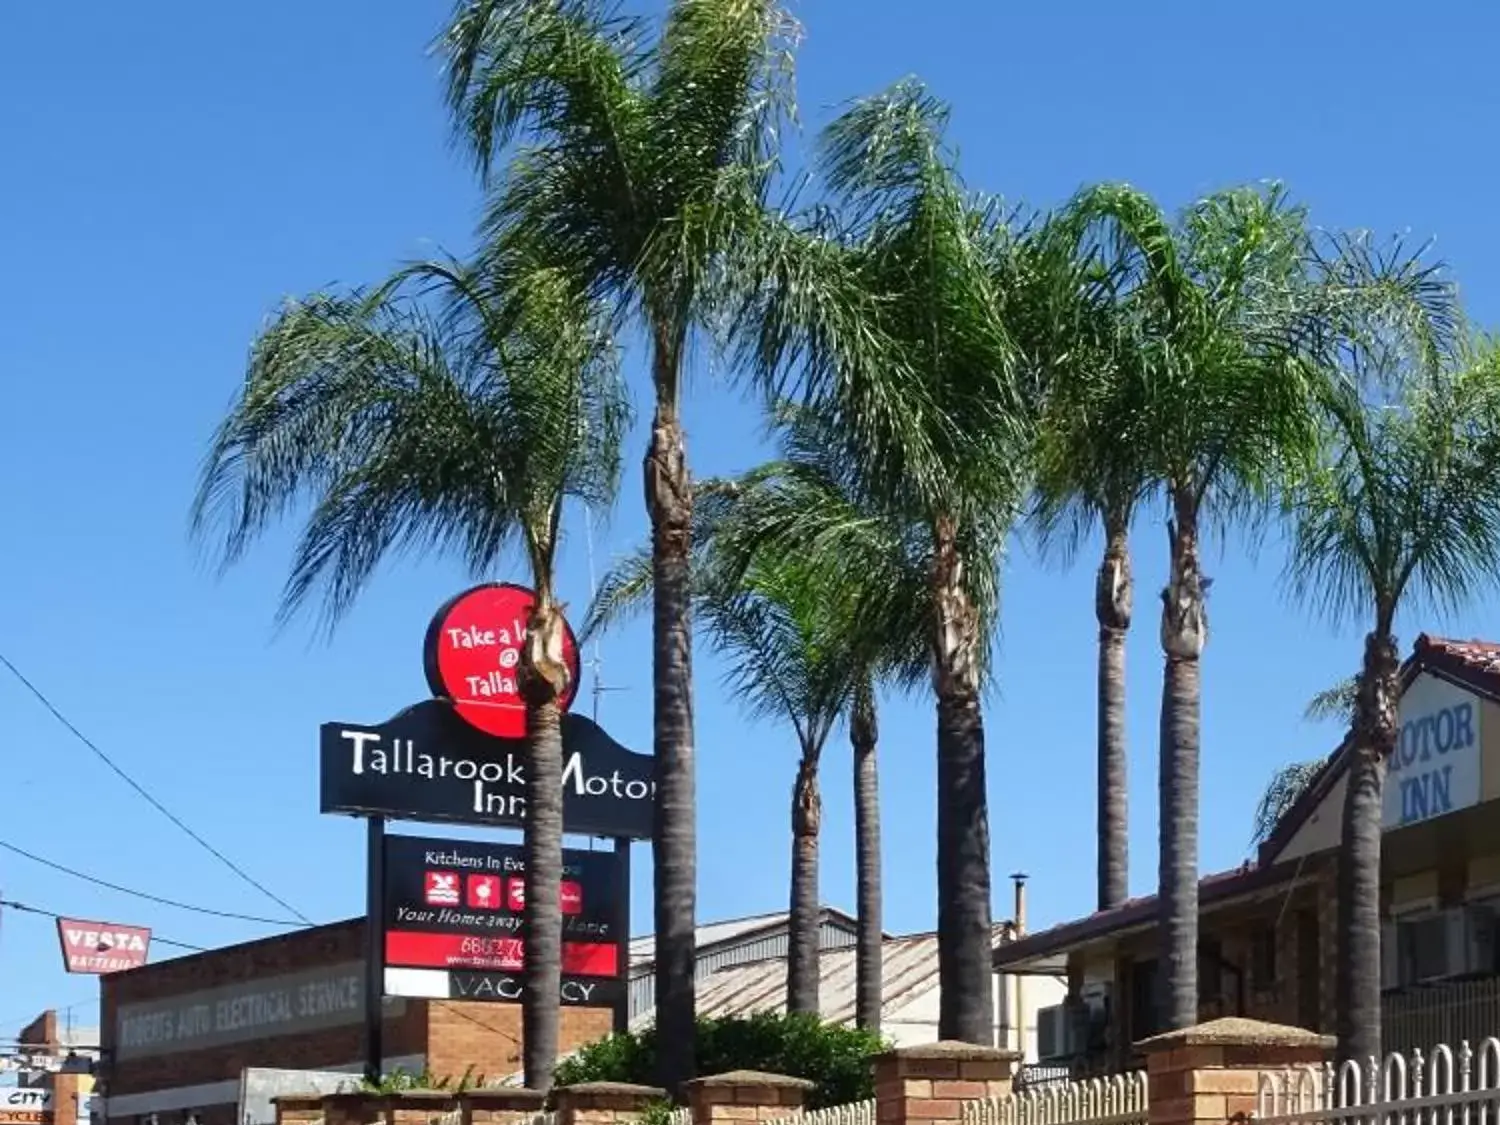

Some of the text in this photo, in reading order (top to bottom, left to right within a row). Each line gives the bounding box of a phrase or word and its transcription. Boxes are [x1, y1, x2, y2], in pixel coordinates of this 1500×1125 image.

[447, 624, 496, 649] Take
[499, 628, 511, 645] a
[498, 647, 519, 668] @
[464, 670, 518, 697] Talla
[341, 730, 656, 801] Tallarook Motor
[473, 779, 527, 817] Inn
[1399, 765, 1454, 822] INN
[425, 850, 525, 872] Kitchens In Eve
[396, 908, 433, 922] Your
[437, 908, 484, 926] Home
[486, 914, 524, 932] away
[65, 930, 146, 951] VESTA
[453, 972, 596, 1002] VACCY
[177, 1005, 211, 1038] AUTO
[216, 991, 293, 1031] ELECTRICAL
[299, 976, 359, 1017] SERVICE
[8, 1091, 52, 1105] CITY
